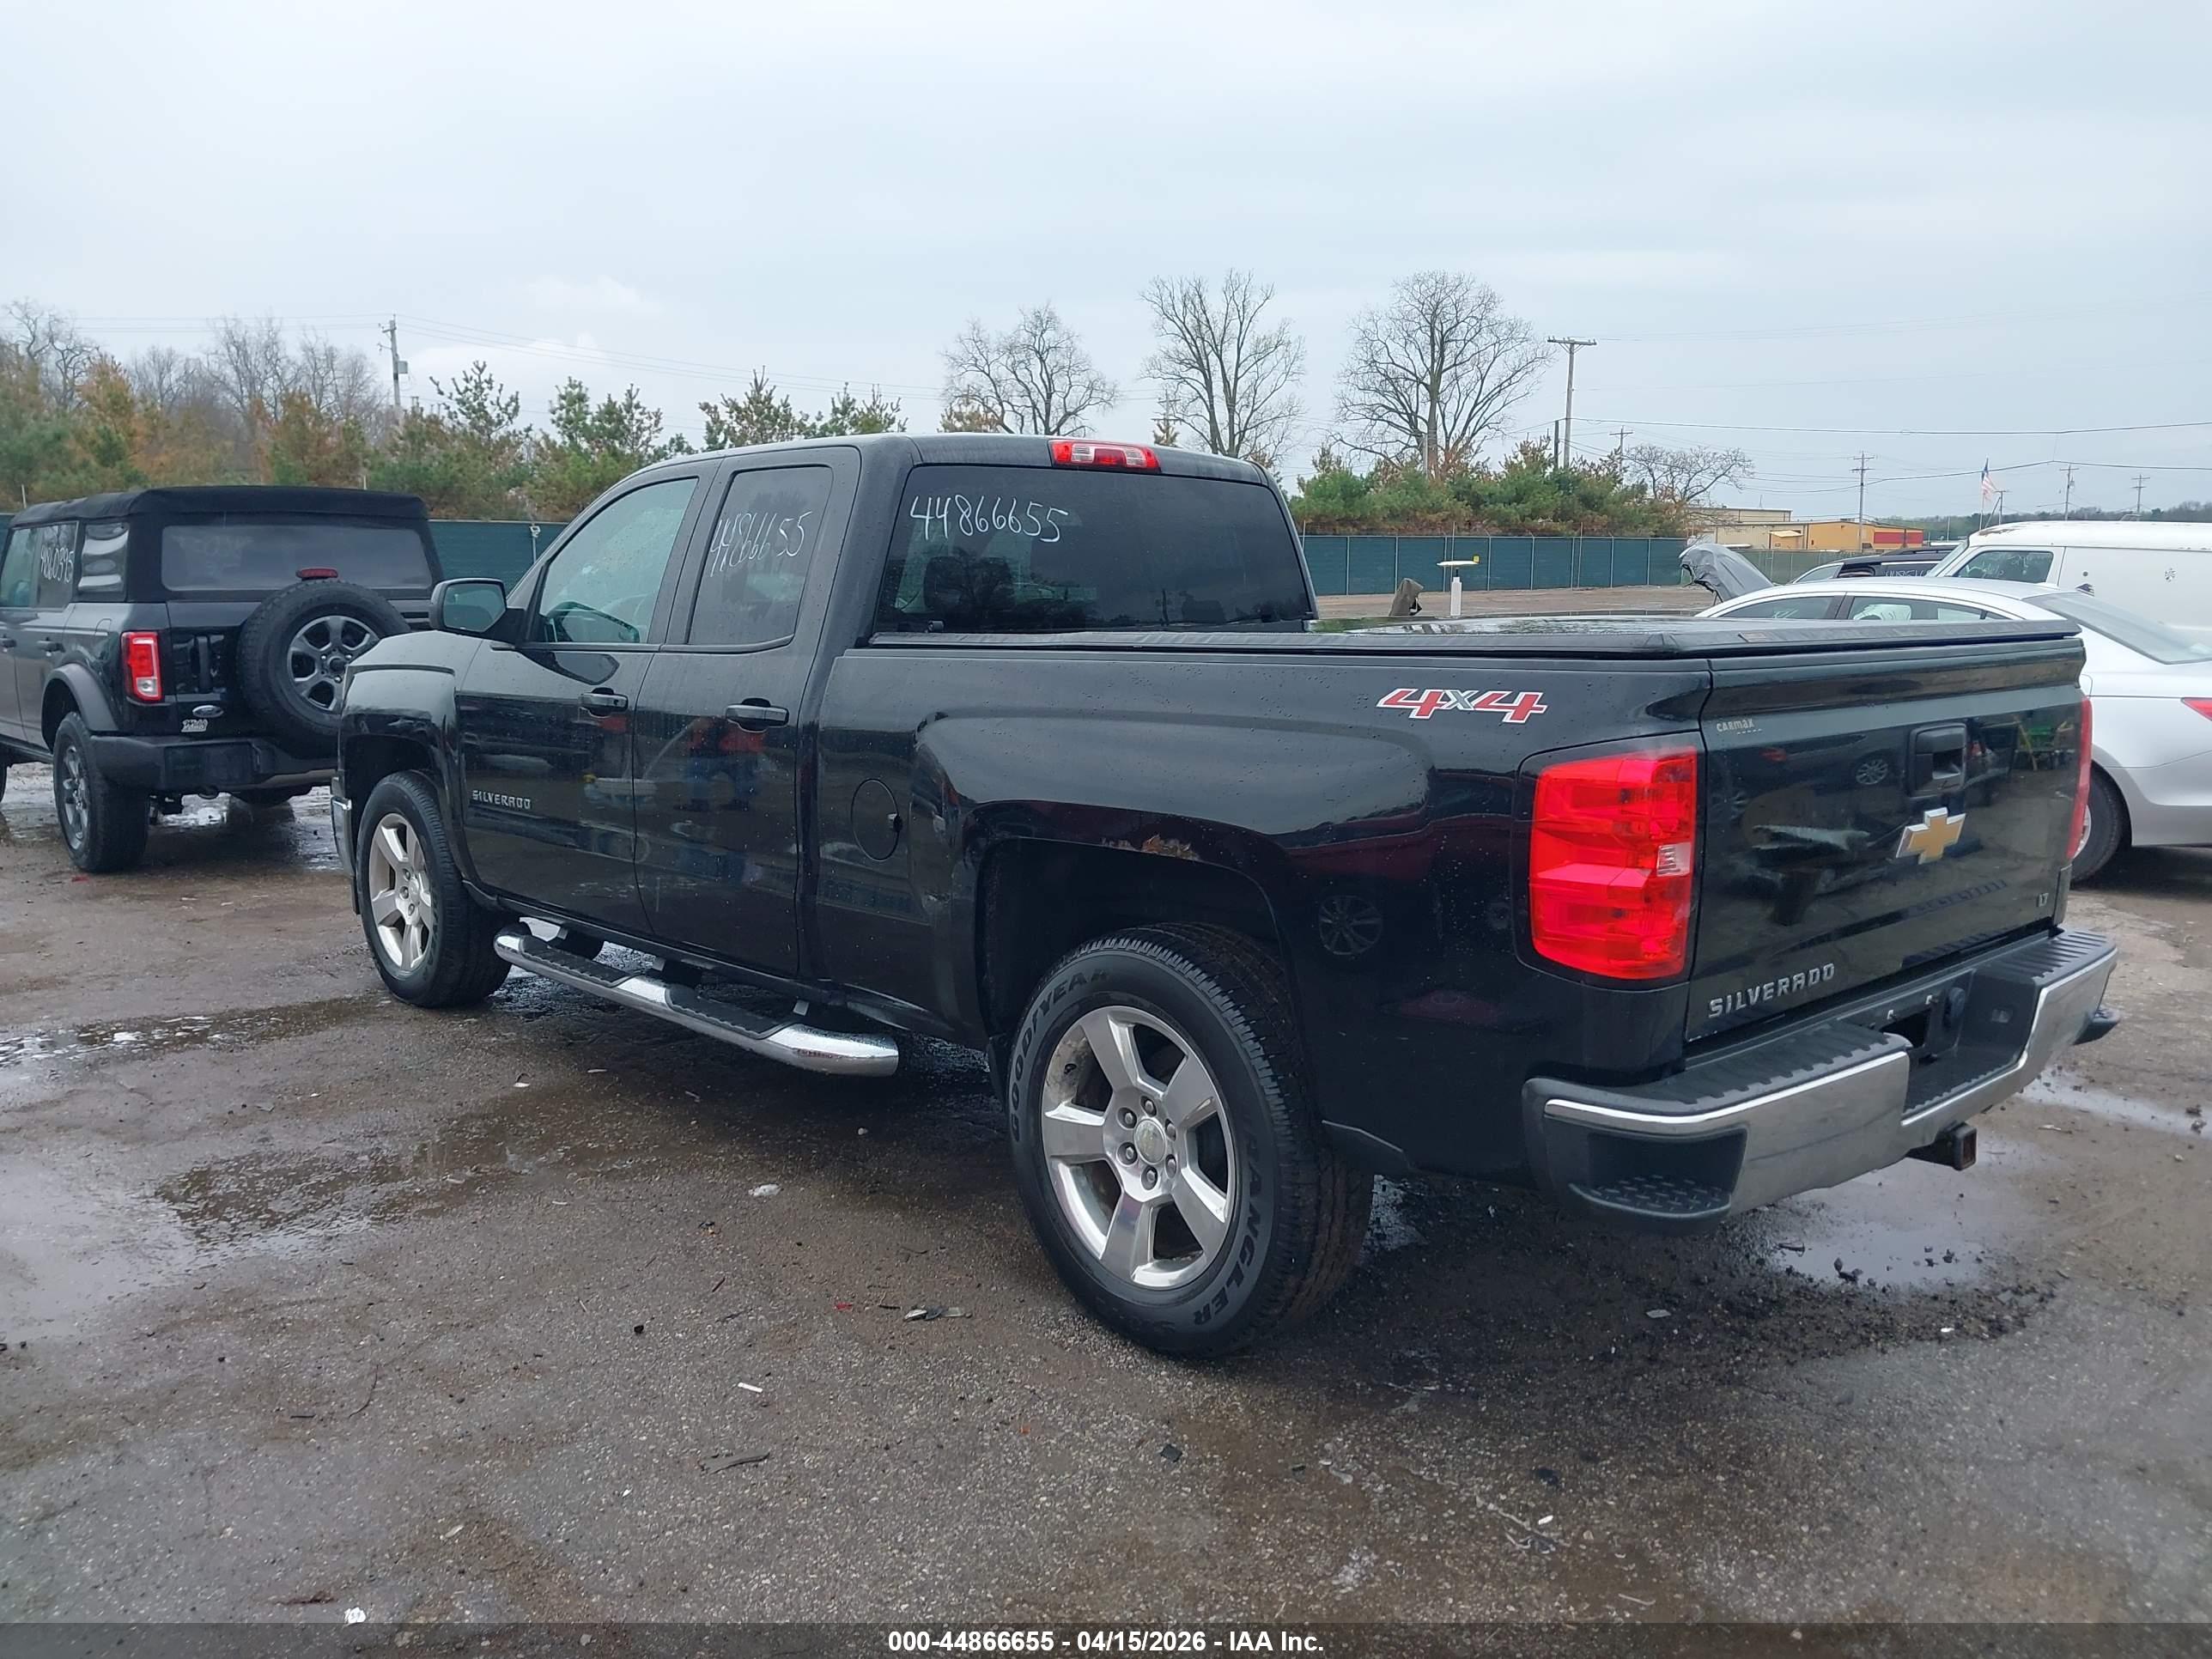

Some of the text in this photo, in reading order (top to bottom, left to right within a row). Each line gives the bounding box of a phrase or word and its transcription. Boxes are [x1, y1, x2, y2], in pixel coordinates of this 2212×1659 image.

[909, 494, 1069, 543] 44866655
[472, 790, 531, 810] SILVERADO
[1708, 963, 1835, 1019] SILVERADO
[1193, 1123, 1262, 1325] RANGLER
